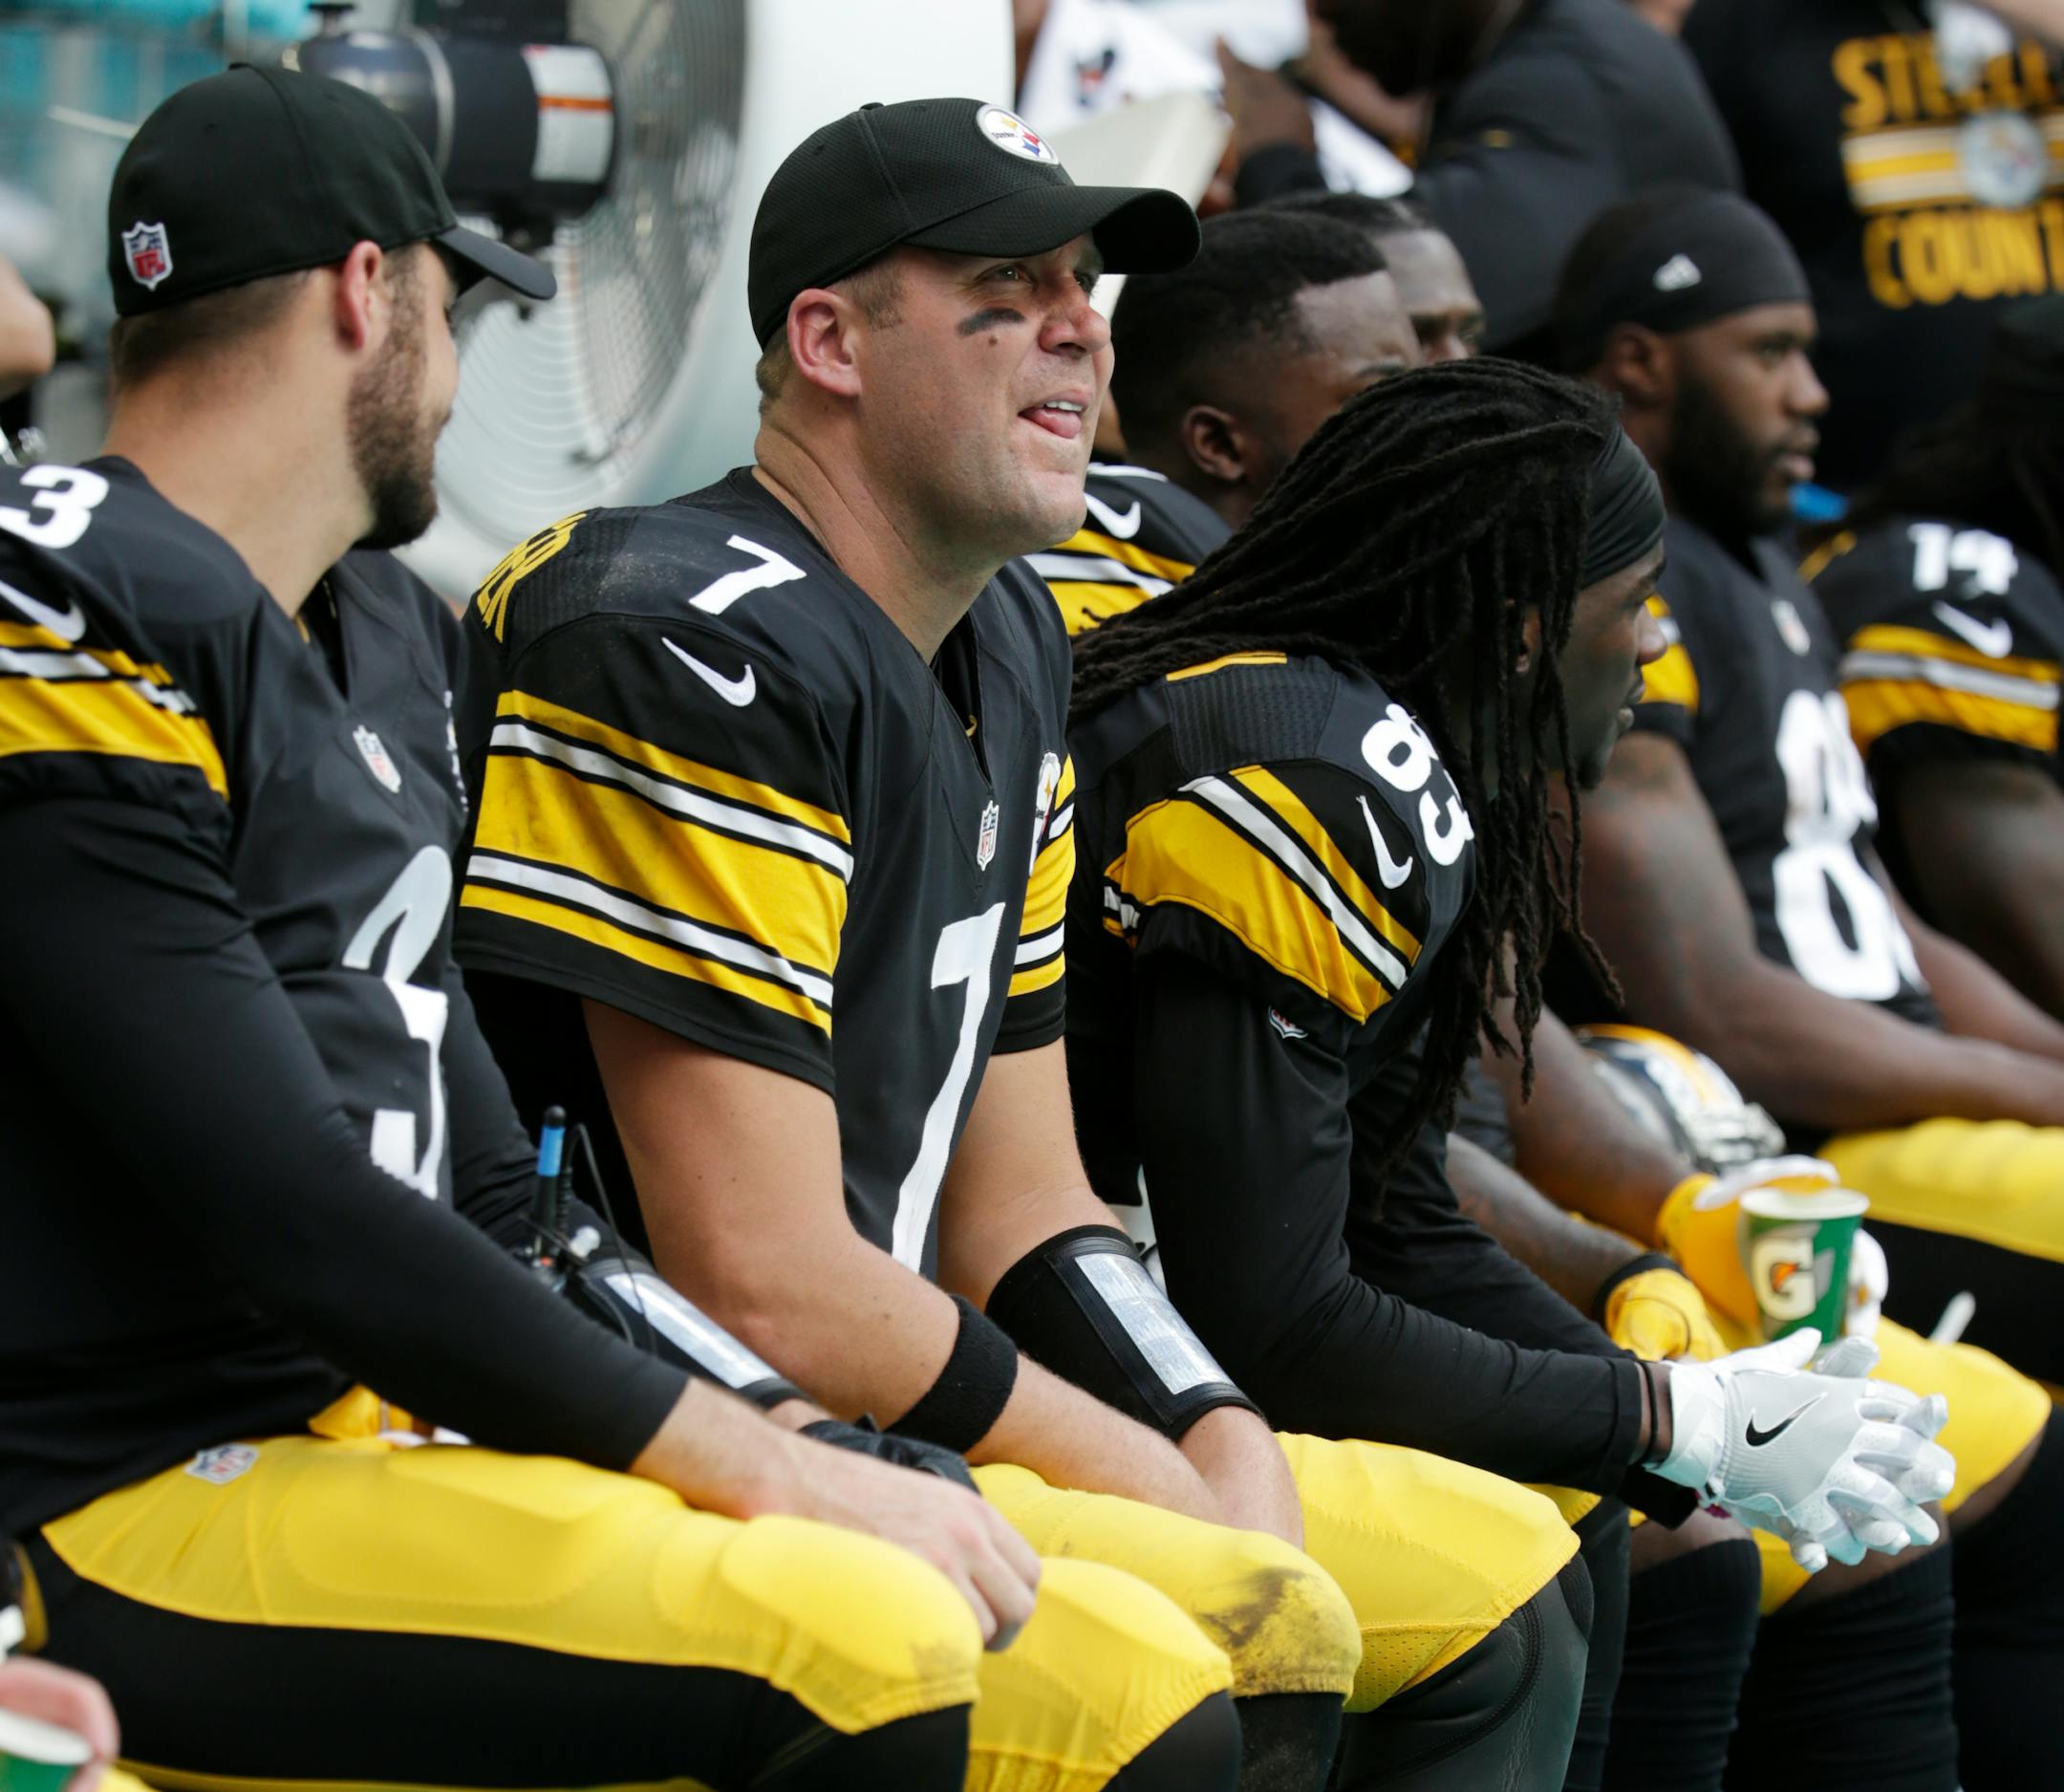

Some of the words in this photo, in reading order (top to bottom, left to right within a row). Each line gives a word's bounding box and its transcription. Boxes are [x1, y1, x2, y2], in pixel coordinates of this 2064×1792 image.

[0, 464, 109, 550] 3
[688, 534, 807, 615] 7
[1361, 701, 1475, 866] 83
[892, 901, 1006, 1276] 7
[1751, 1235, 1816, 1321] G
